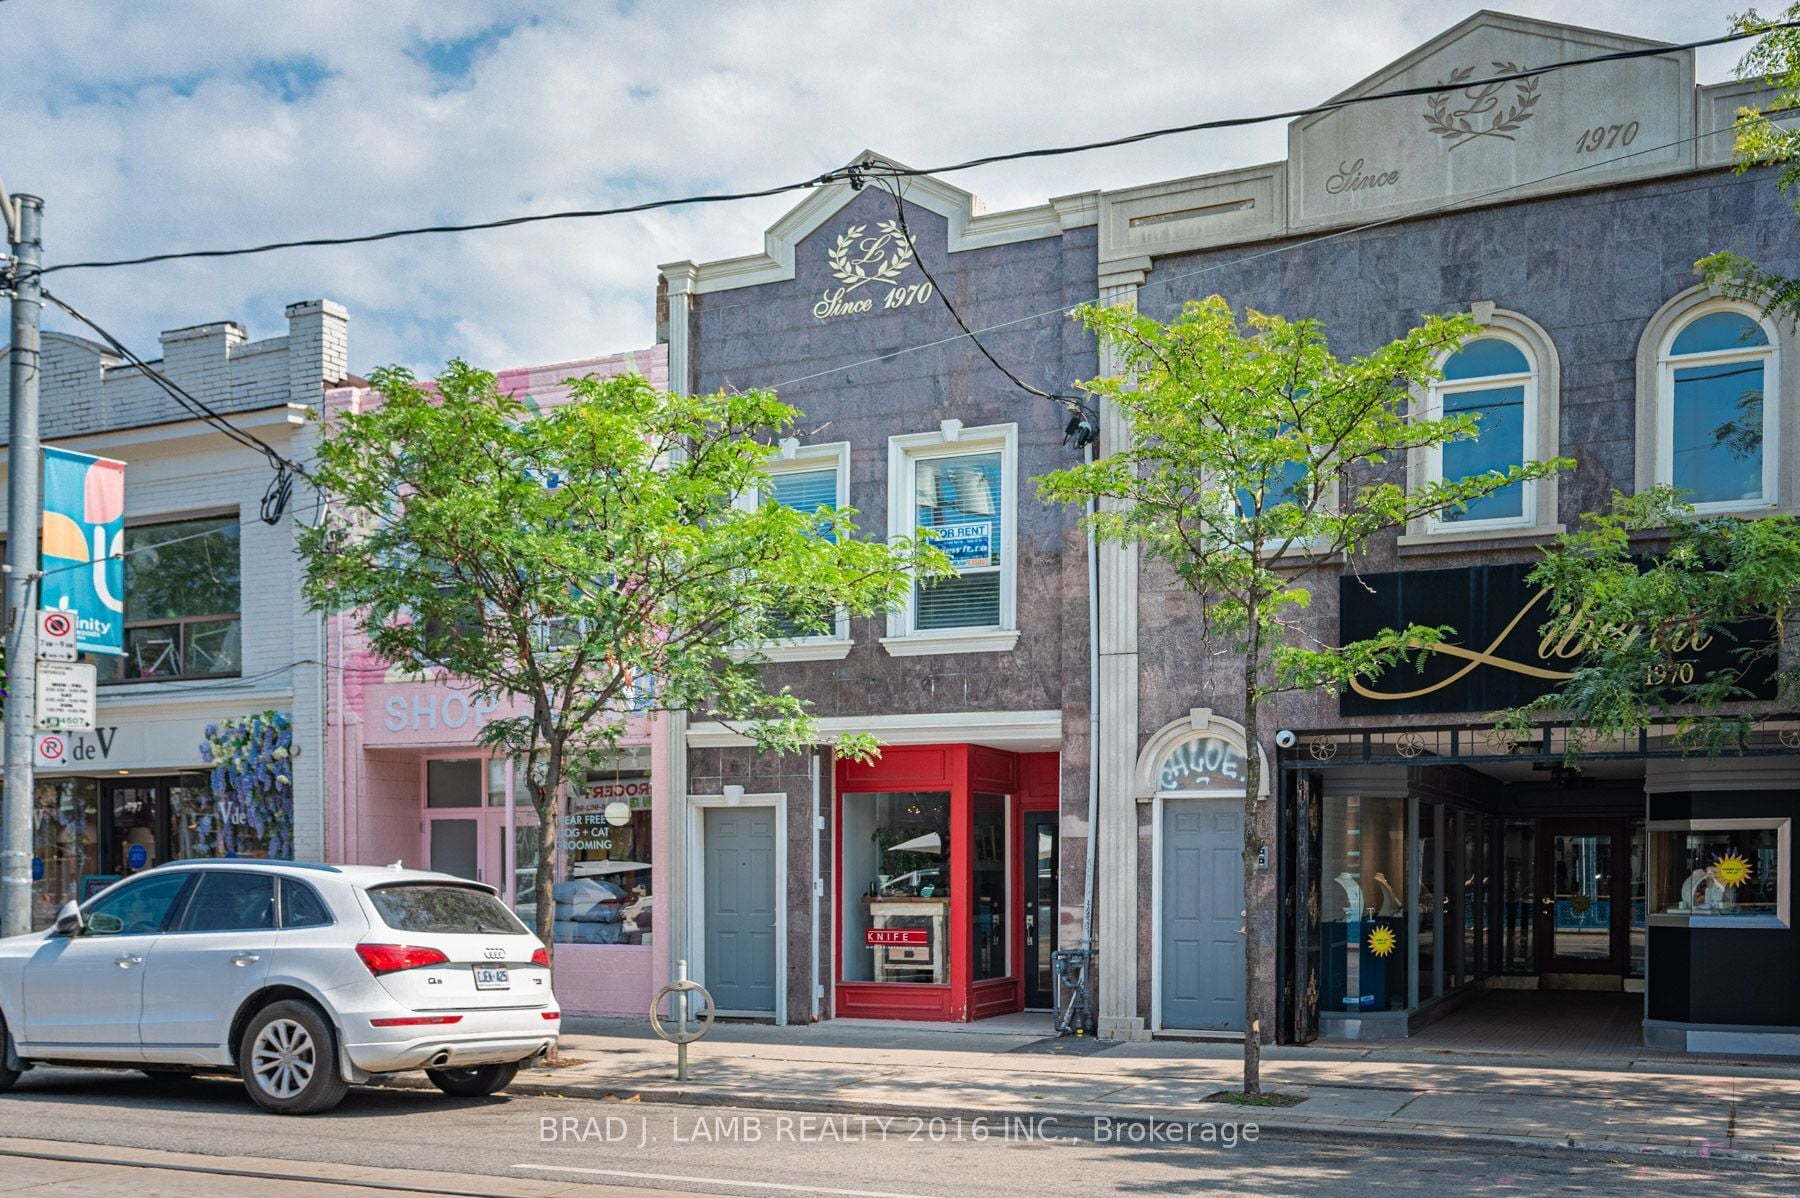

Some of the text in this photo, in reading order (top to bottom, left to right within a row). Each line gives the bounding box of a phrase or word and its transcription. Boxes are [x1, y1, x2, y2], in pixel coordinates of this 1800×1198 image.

[1325, 121, 1641, 195] Since 1970
[851, 234, 892, 265] L
[813, 282, 933, 319] Since 1970
[957, 526, 985, 537] RENT
[76, 617, 111, 634] inity
[384, 691, 498, 732] SHOP
[585, 814, 606, 825] FREE
[591, 827, 610, 837] CAT
[555, 840, 613, 850] GROOMING
[867, 932, 909, 941] KNIFE
